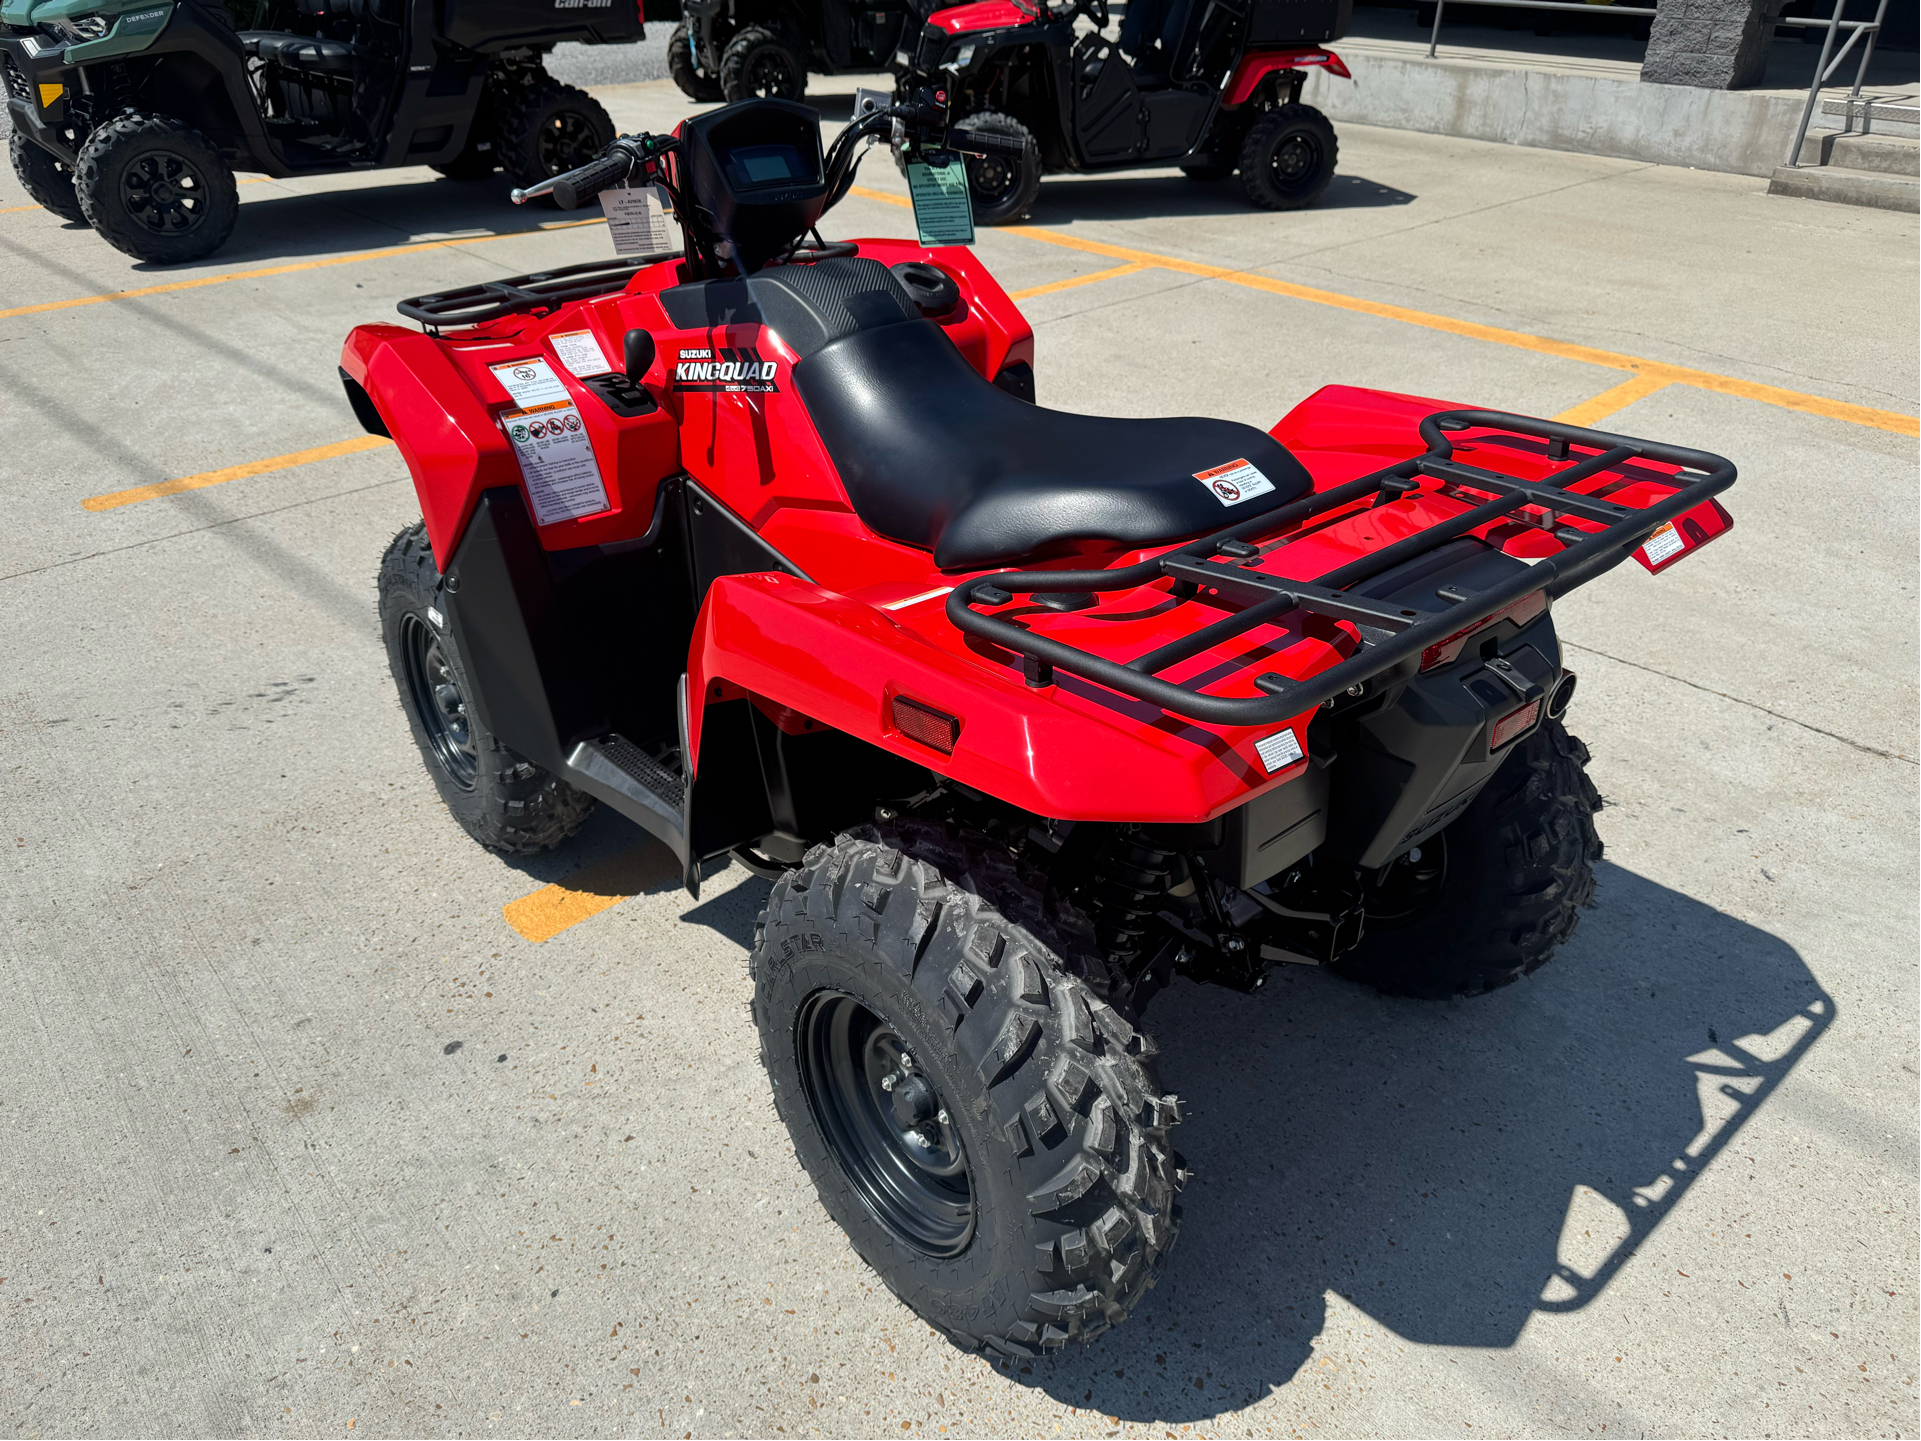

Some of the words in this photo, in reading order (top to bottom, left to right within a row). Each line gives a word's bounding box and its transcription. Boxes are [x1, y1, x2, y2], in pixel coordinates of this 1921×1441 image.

[126, 10, 164, 23] DEFENDER
[680, 349, 711, 358] SUZUKI
[675, 362, 778, 381] KINGQUAD
[528, 404, 556, 414] WARNING
[1214, 463, 1239, 474] WARNING
[761, 931, 827, 1003] CARLSTAR
